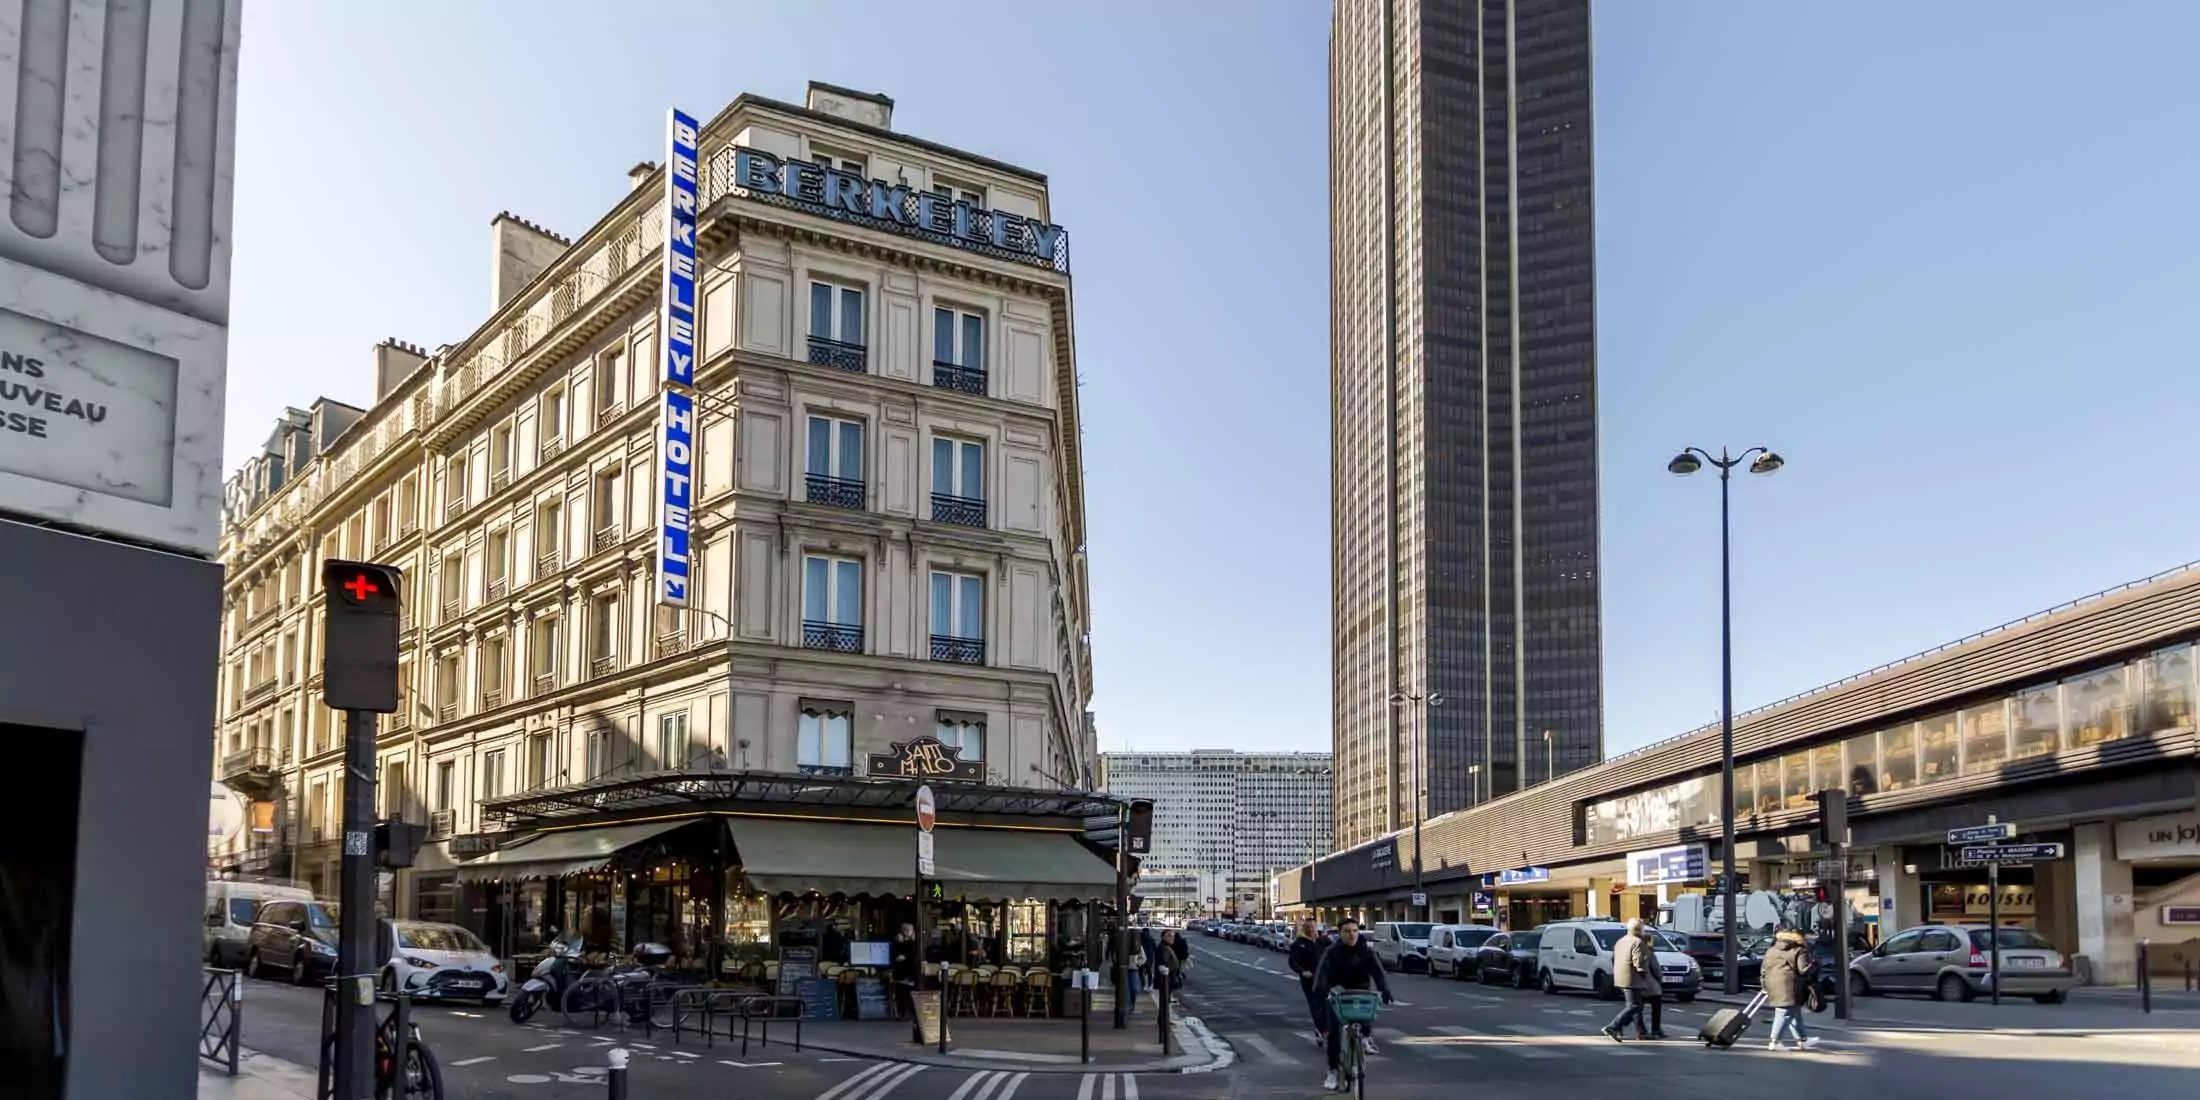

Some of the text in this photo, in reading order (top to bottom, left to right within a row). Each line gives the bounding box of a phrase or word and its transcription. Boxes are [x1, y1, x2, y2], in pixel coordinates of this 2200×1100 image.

[735, 146, 1064, 261] BERKELEY
[664, 119, 697, 563] BERKELEY HOTEL
[2149, 830, 2172, 843] UN
